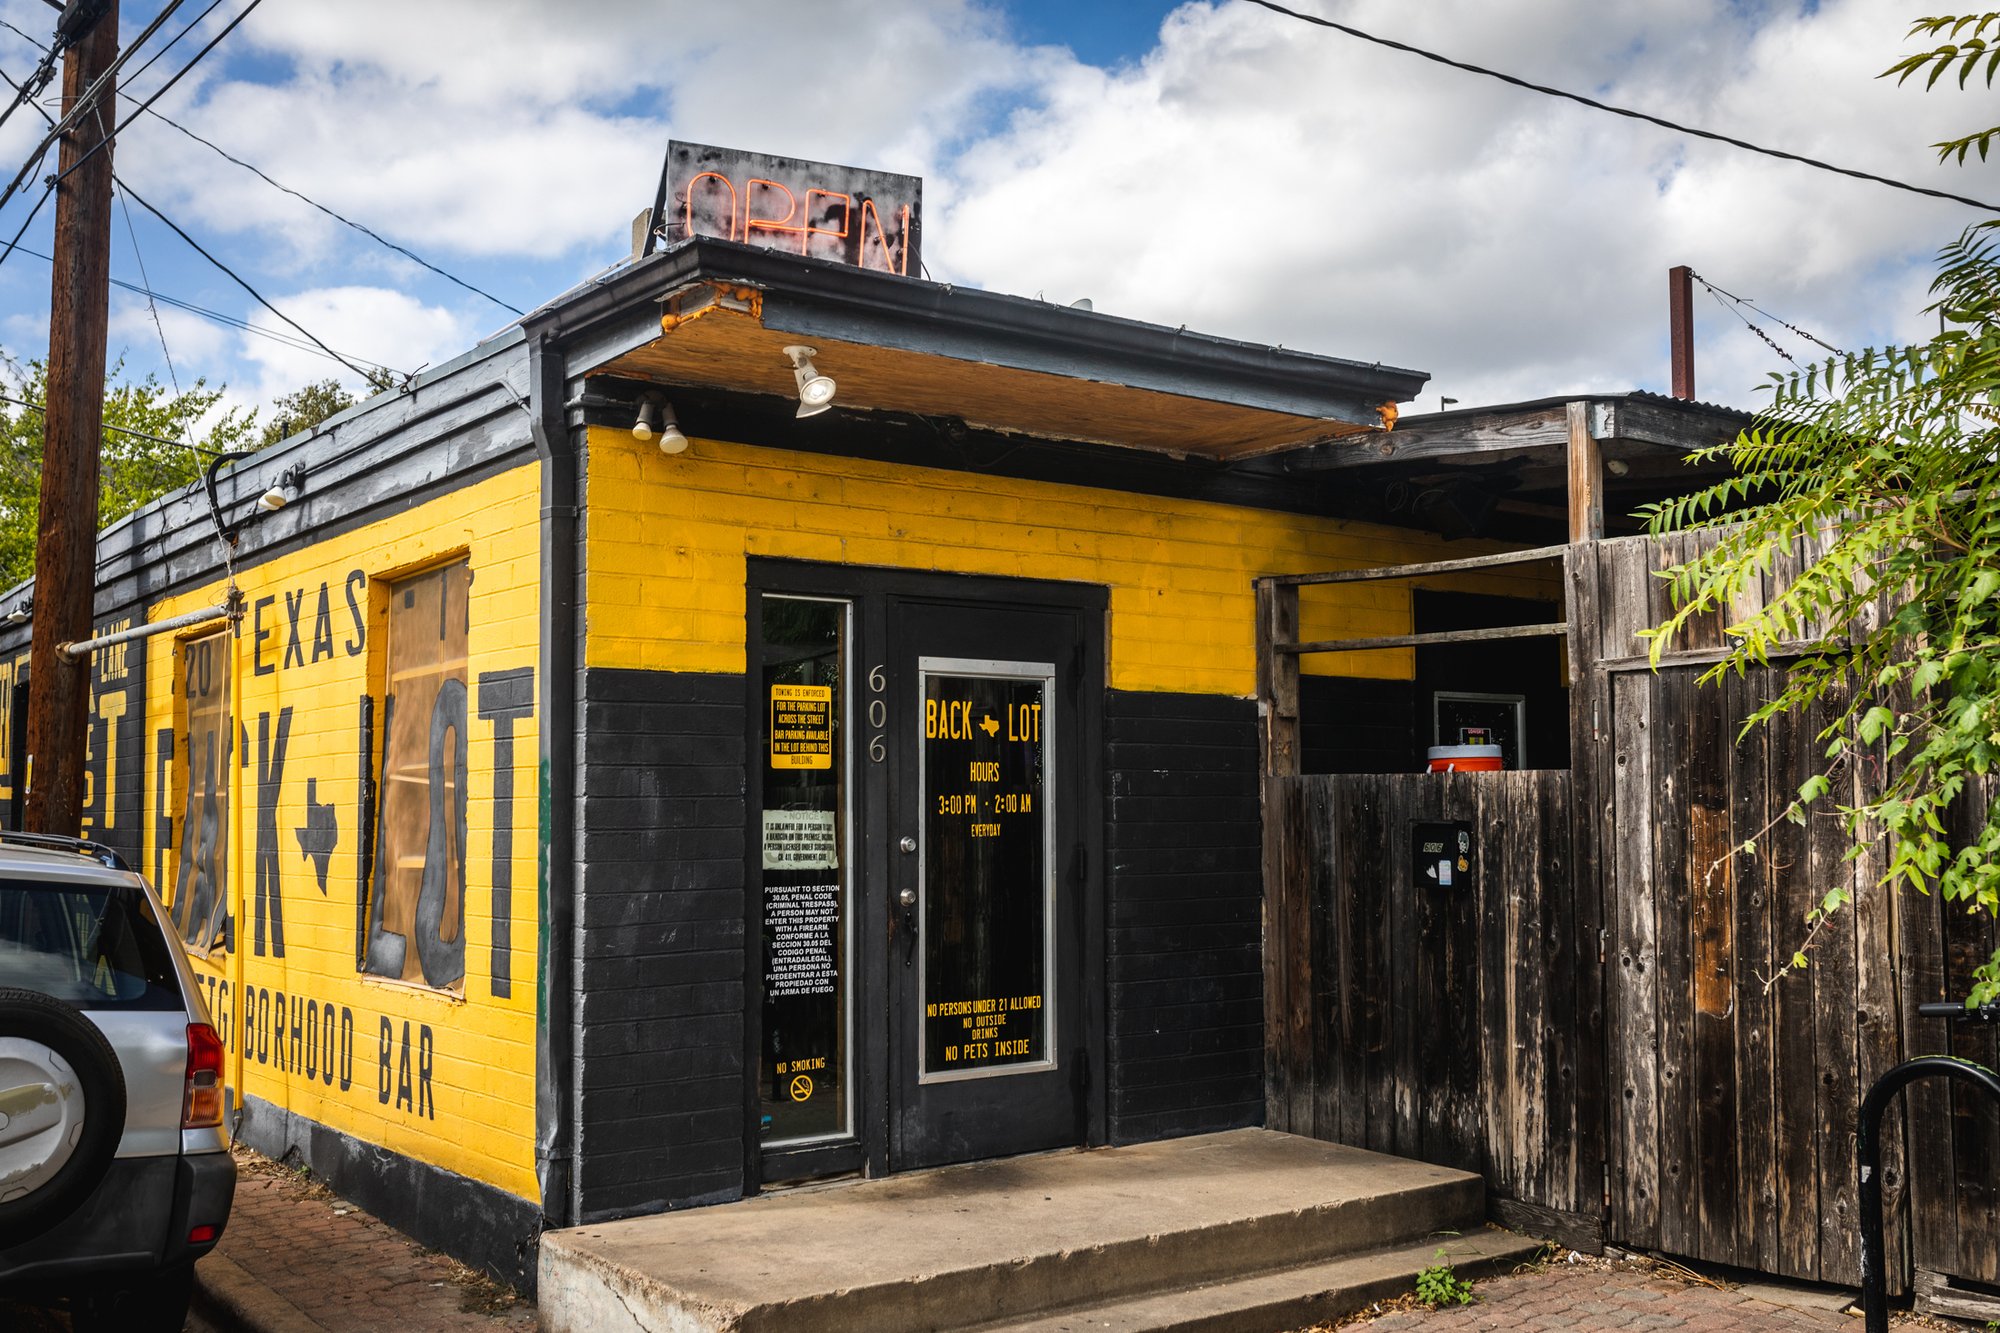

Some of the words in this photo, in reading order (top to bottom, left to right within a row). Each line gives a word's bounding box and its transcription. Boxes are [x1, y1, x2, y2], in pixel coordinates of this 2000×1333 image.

[686, 172, 910, 276] OPEN
[776, 688, 792, 696] TOWING
[803, 689, 825, 697] ENFORCED
[777, 701, 786, 711] FOR
[787, 702, 796, 711] THE
[797, 702, 816, 712] PARKING
[818, 702, 826, 712] LOT
[778, 714, 796, 724] ACROSS
[798, 714, 806, 724] THE
[807, 715, 824, 724] STREET
[869, 664, 887, 763] 606
[926, 699, 972, 740] BACK
[1009, 703, 1041, 742] LOT
[775, 730, 784, 739] BAR
[785, 730, 805, 740] PARKING
[806, 730, 828, 740] AVAILABLE
[775, 743, 780, 752] IN
[781, 743, 789, 752] THE
[791, 743, 799, 752] LOT
[800, 743, 817, 752] BEHIND
[818, 743, 828, 752] THIS
[791, 755, 813, 765] BUILDING
[970, 762, 1000, 782] HOURS
[939, 795, 961, 815] 3:00
[965, 794, 976, 814] PM
[995, 794, 1017, 814] 2:00
[1021, 794, 1031, 813] AM
[356, 667, 535, 999] LOT
[971, 824, 1000, 837] EVERYDAY
[766, 902, 800, 911] (CRIMINAL
[772, 941, 801, 949] SECCION
[789, 963, 820, 971] PERSONA
[775, 980, 813, 988] PROPIEDAD
[781, 988, 800, 996] ARMA
[928, 1004, 937, 1017] NO
[940, 1000, 971, 1016] PERSONS
[973, 999, 996, 1014] UNDER
[999, 998, 1008, 1011] 21
[1010, 995, 1041, 1010] ALLOWED
[963, 1017, 972, 1029] NO
[976, 1014, 1007, 1027] OUTSIDE
[972, 1027, 998, 1040] DRINKS
[196, 974, 354, 1092] IGBORHOOD
[378, 1015, 435, 1121] BAR
[945, 1046, 958, 1062] NO
[964, 1043, 988, 1059] PETS
[995, 1039, 1030, 1057] INSIDE
[777, 1062, 787, 1074] NO
[791, 1057, 825, 1072] SMOKING
